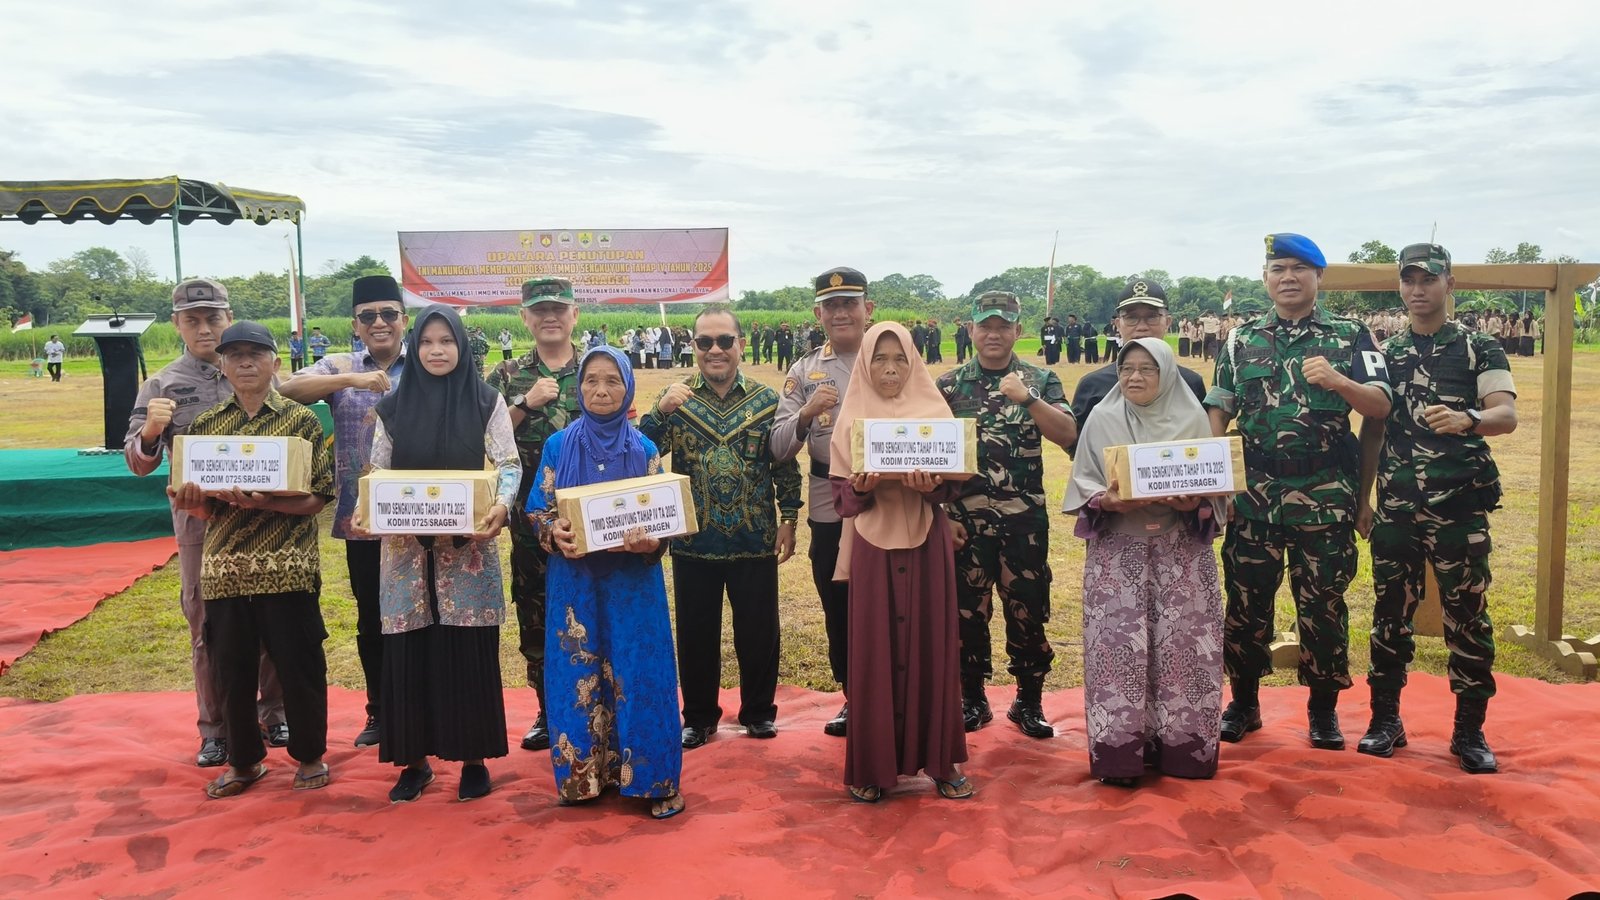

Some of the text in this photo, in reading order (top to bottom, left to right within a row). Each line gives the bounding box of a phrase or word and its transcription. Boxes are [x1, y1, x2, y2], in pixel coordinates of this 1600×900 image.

[486, 250, 645, 262] UPACARA PENUTUPAN
[417, 262, 712, 276] TNI MANUNGGAL MEMBANGUN DESA (TMMD) SENGKUYUNG TAHAP IV TAHUN 2025
[872, 442, 956, 453] TMMD SENGKUYUNG TAHAP IV TA 2025
[191, 460, 279, 472] TMMD SENGKUYUNG TAHAP IV TA 2025
[881, 457, 902, 465] KODIM
[1137, 461, 1224, 479] TMMD SENGKUYUNG TAHAP IV TA 2025
[200, 475, 224, 483] KODIM
[1148, 481, 1170, 490] KODIM
[377, 502, 465, 515] TMMD SENGKUYUNG TAHAP IV TA 2025
[387, 518, 410, 527] KODIM
[591, 505, 676, 532] TMMD SENGKUYUNG TAHAP IV TA 2025
